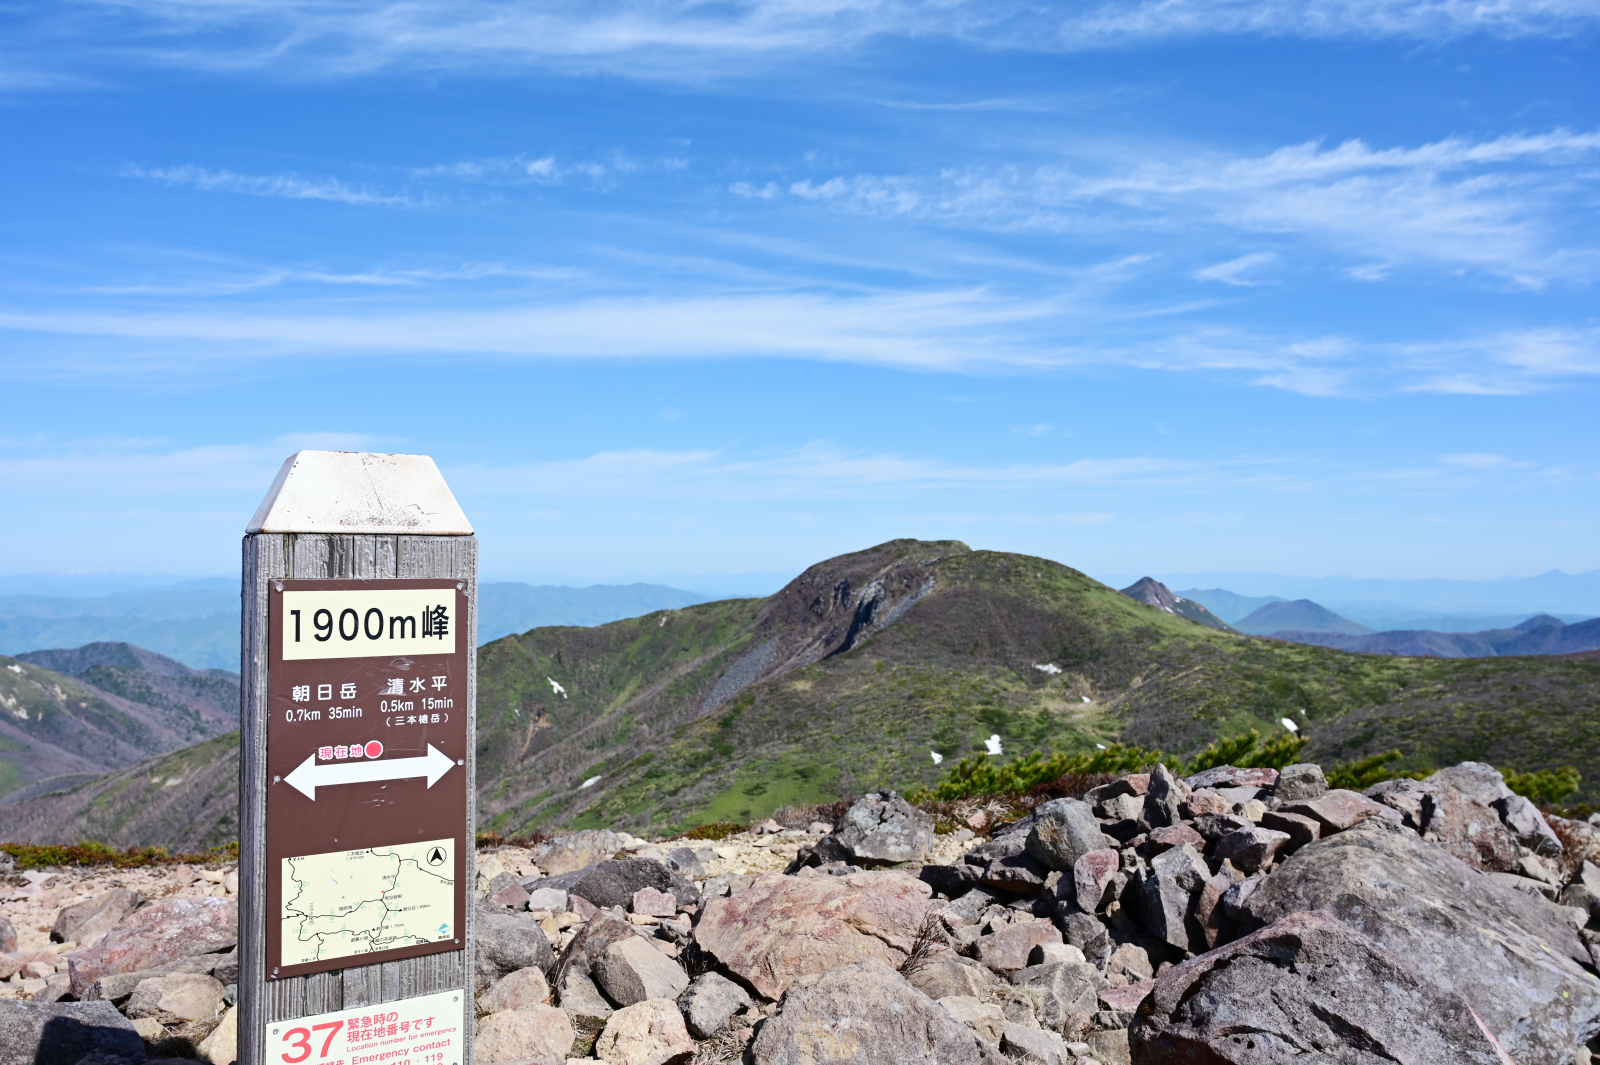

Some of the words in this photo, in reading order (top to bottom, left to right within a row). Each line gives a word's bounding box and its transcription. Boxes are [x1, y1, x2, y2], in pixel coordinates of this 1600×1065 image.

[290, 604, 450, 643] 1900m峰
[291, 683, 358, 703] 朝日岳
[386, 675, 448, 695] 清水平
[285, 708, 321, 722] 0.7km
[328, 705, 363, 720] 35min
[380, 699, 414, 713] 0.5km
[421, 696, 454, 710] 15min
[318, 743, 364, 760] 現在地
[346, 1016, 436, 1044] 現在地番号です
[347, 1011, 399, 1031] 緊急時の
[280, 1020, 345, 1064] 37
[346, 1041, 378, 1053] Location
[380, 1035, 407, 1046] number
[408, 1032, 419, 1041] for
[420, 1026, 457, 1039] emergency
[351, 1047, 410, 1065] Emergency
[413, 1038, 451, 1053] contact
[424, 1052, 444, 1063] 119
